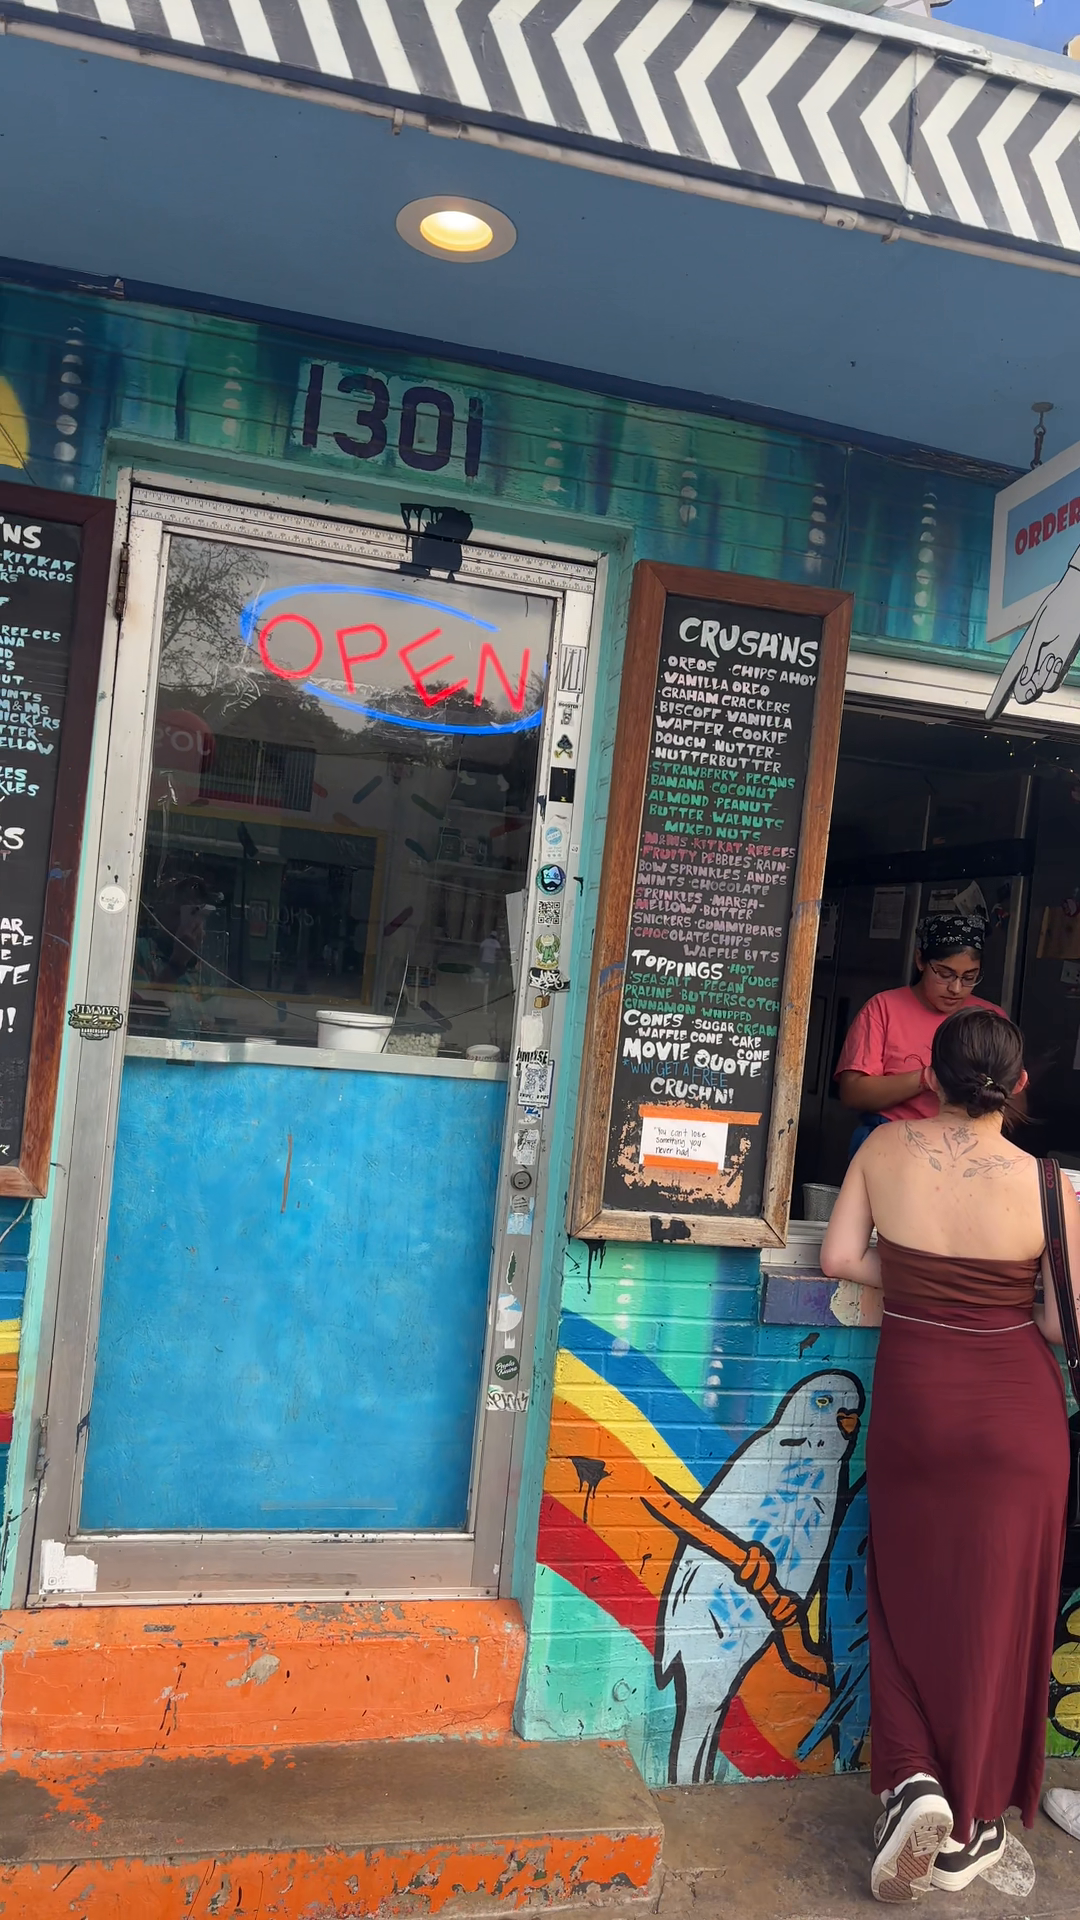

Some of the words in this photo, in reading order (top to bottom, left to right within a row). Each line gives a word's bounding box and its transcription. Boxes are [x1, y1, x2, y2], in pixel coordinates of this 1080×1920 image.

[303, 364, 483, 477] 1301
[1015, 496, 1080, 555] ORDER
[28, 567, 74, 583] OREOS
[1, 624, 61, 643] REECES
[258, 612, 531, 713] OPEN
[667, 655, 717, 673] OREOS
[731, 664, 777, 683] CHIPS
[779, 669, 816, 687] AHOY
[663, 671, 729, 692] VANILLA
[731, 680, 770, 697] OREO
[661, 686, 719, 706] GRAHAM
[721, 695, 790, 715] CRACKERS
[659, 700, 722, 721] BISCOFF
[726, 710, 793, 731] VANILLA
[655, 730, 706, 750] DOUGH
[656, 715, 724, 737] WAFFER
[732, 727, 788, 745] COOKIE
[654, 746, 782, 774] NUTTERBUTTER
[650, 774, 705, 792] BANANA
[711, 781, 777, 800] COCONUT
[652, 761, 738, 782] STRAWBERRY
[745, 773, 796, 790] PECANS
[648, 790, 709, 808] ALMOND
[649, 803, 704, 822] BUTTER
[713, 811, 785, 831] WALNUTS
[664, 820, 713, 837] MIXED
[716, 827, 762, 843] NUTS
[644, 831, 688, 848] M&MS
[747, 844, 797, 859] REECES
[642, 845, 698, 864] FRUITY
[701, 851, 752, 869] PEBBLES
[755, 859, 791, 872] RAIN-
[639, 859, 667, 874] BOW
[669, 862, 741, 881] SPRINKLES
[746, 871, 788, 886] ANDES
[637, 873, 686, 888] MINTS
[690, 878, 771, 897] CHOCOLATE
[634, 898, 697, 915] MELLOW
[703, 905, 754, 921] BUTTER
[635, 886, 703, 905] SPRINKLES
[711, 894, 766, 909] MARSH-
[632, 911, 692, 928] SNICKERS
[633, 926, 710, 945] CHOCOLATE
[711, 933, 752, 948] CHIPS
[631, 949, 724, 980] TOPPINGS
[729, 963, 755, 975] HOT
[683, 944, 739, 960] WAFFLE
[744, 950, 780, 964] BITS
[631, 972, 657, 985] SEA
[659, 975, 692, 988] SALT
[703, 979, 745, 994] PECAN
[741, 974, 780, 989] FUDGE
[624, 984, 675, 1000] PRALINE
[681, 991, 780, 1012] BUTTERSCOTCH
[74, 1005, 119, 1016] JIMMYS
[623, 1009, 684, 1028] CONES
[694, 1019, 735, 1033] SUGAR
[624, 999, 696, 1015] CINNAMON
[701, 1007, 752, 1022] WHIPPED
[638, 1027, 688, 1041] WAFFLE
[689, 1031, 723, 1046] CONE
[732, 1034, 762, 1050] CAKE
[736, 1023, 778, 1037] CREAM
[622, 1037, 691, 1065] MOVIE
[693, 1049, 762, 1078] QUOTE
[736, 1050, 770, 1061] CONE
[656, 1061, 681, 1076] GET
[682, 1063, 691, 1075] A
[691, 1066, 728, 1088] FREE
[655, 1146, 674, 1154] never
[689, 1139, 702, 1149] you
